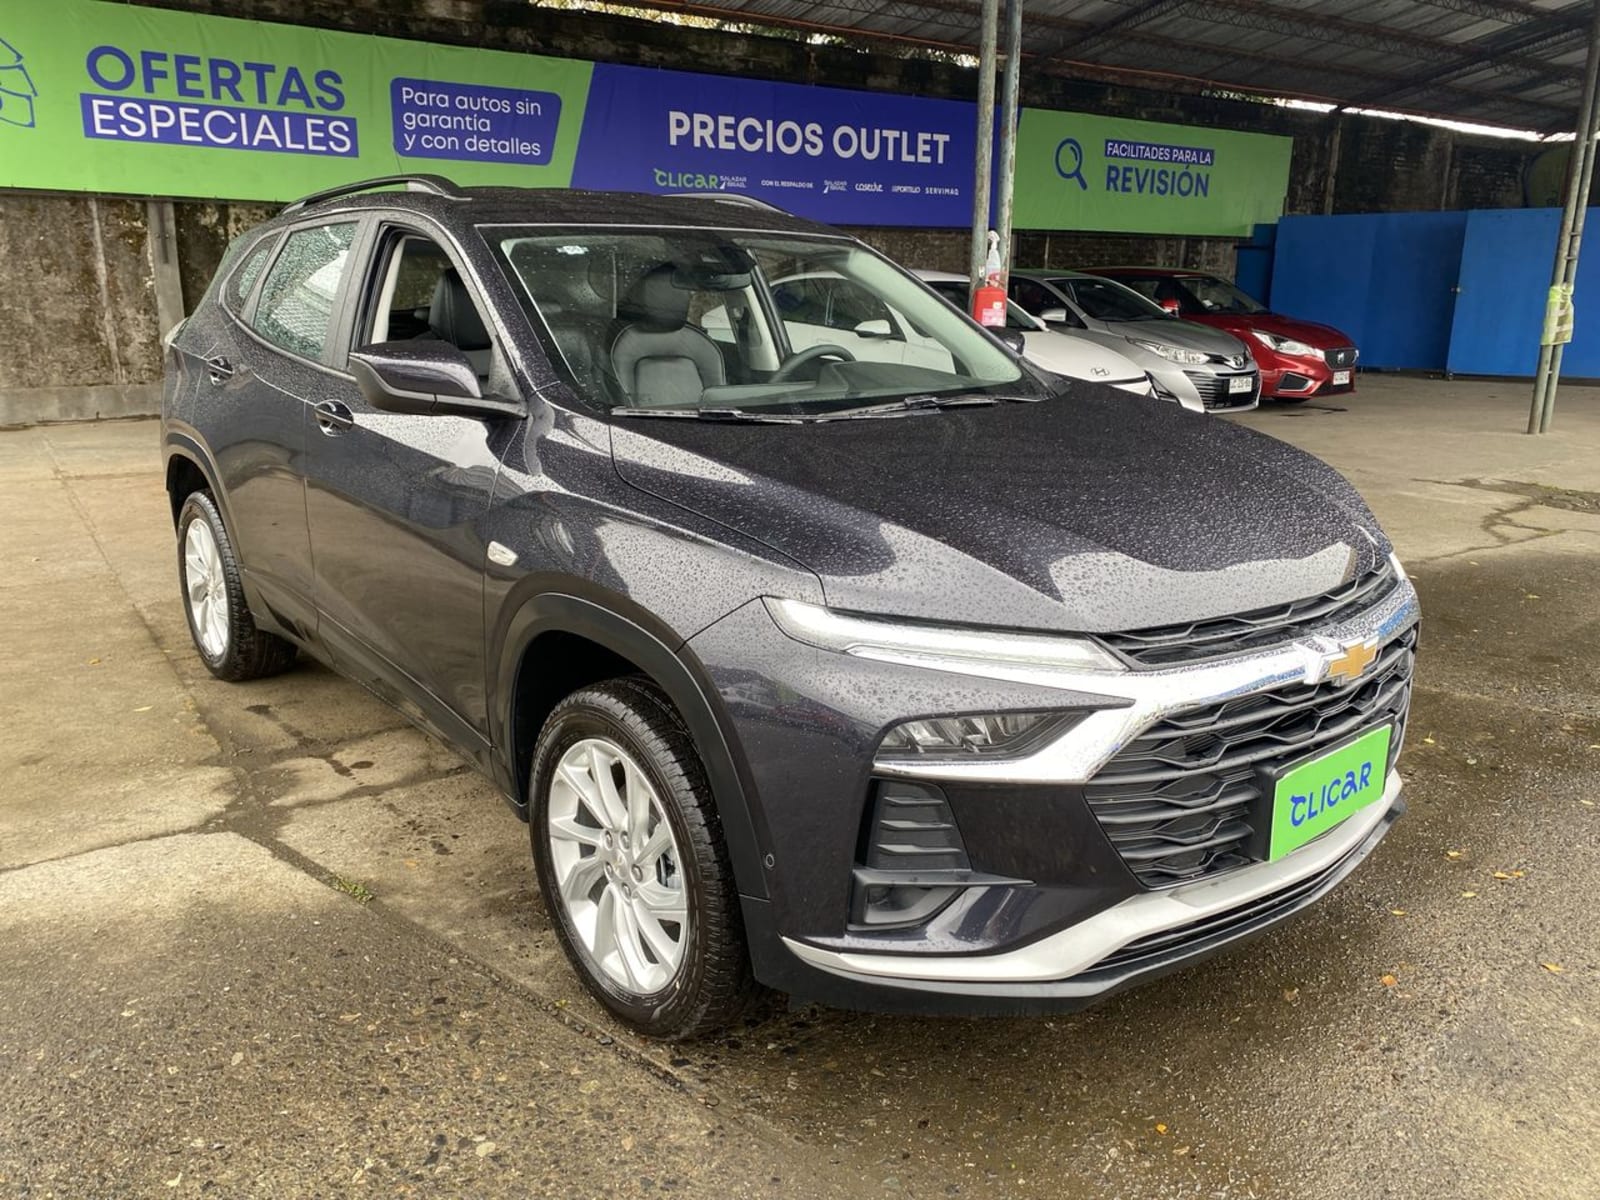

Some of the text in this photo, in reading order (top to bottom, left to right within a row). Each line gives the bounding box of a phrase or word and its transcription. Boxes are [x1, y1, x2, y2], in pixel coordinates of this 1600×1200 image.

[86, 45, 345, 111] OFERTAS
[402, 87, 541, 116] Para autos sin
[92, 99, 351, 153] ESPECIALES
[403, 111, 491, 132] garantía
[668, 110, 950, 164] PRECIOS OUTLET
[404, 133, 541, 156] y con detalles
[1106, 142, 1212, 164] FACILITADES PARA LA
[1106, 164, 1209, 197] REVISIÓN
